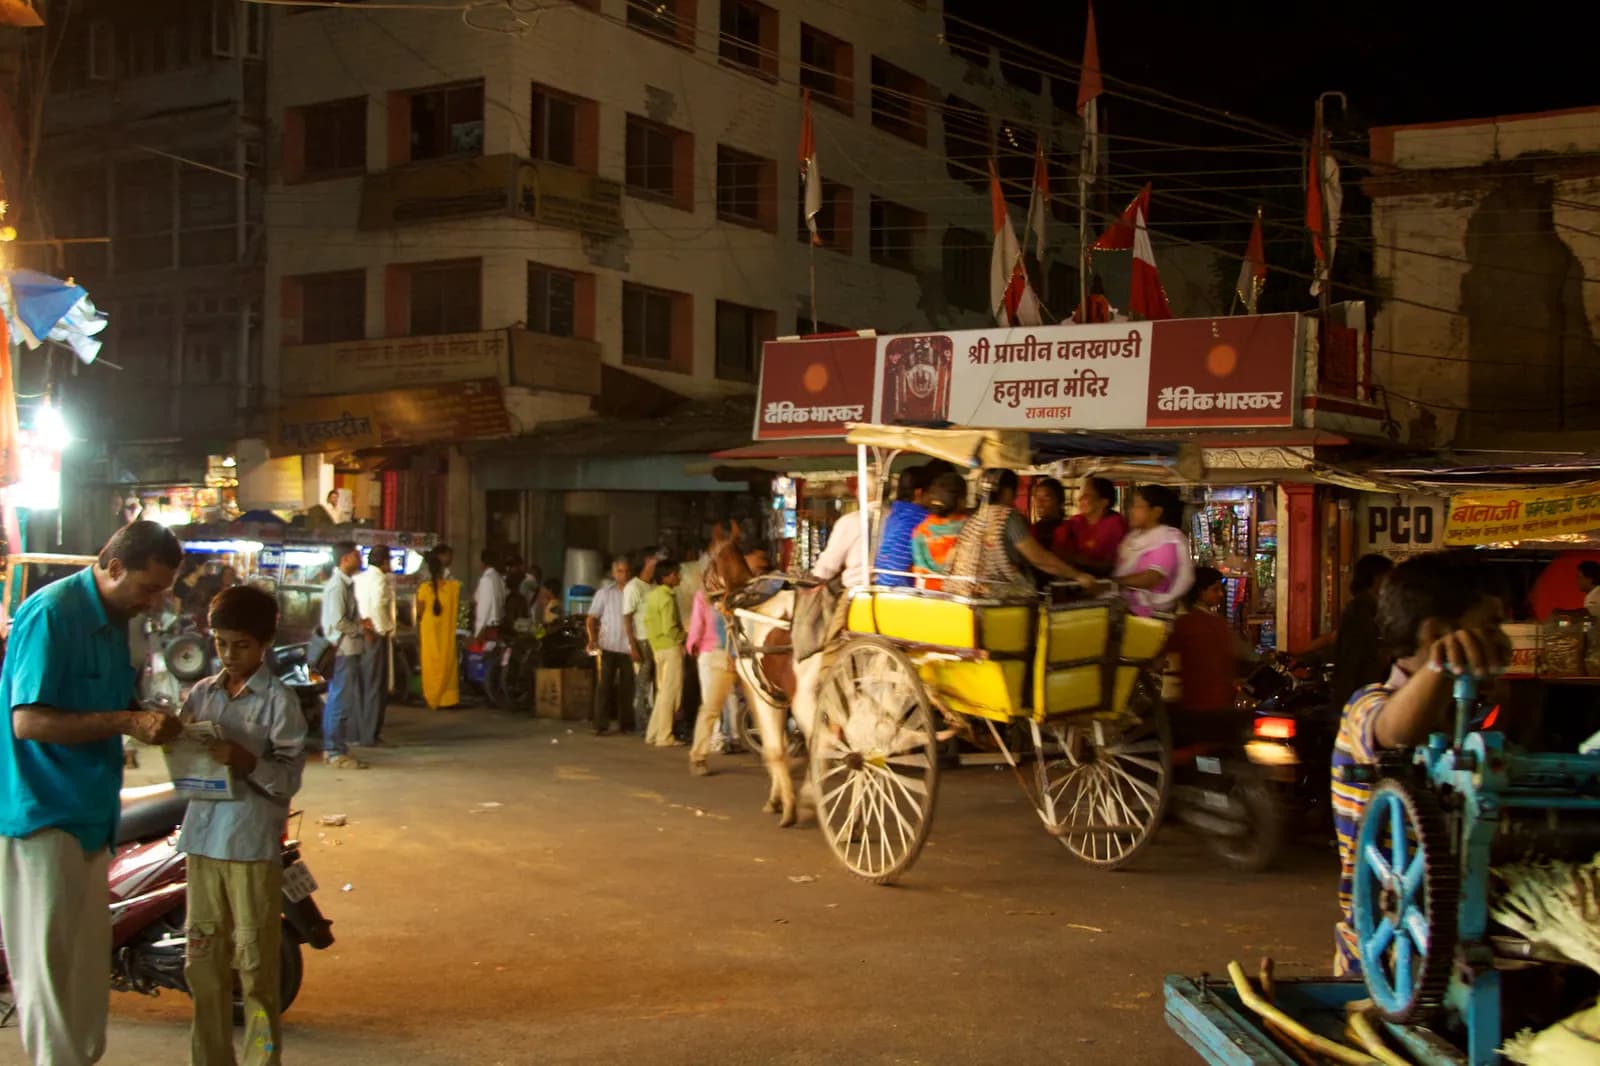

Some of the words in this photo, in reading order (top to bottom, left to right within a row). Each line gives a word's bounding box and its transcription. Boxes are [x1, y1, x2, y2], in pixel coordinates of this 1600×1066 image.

[968, 337, 991, 364] श्री
[993, 334, 1053, 364] प्राचीन
[1057, 330, 1142, 360] वनखण्डी
[993, 378, 1060, 408] हनुमान
[1063, 368, 1110, 398] मंदिर
[1157, 386, 1215, 411] दैनिक
[1215, 392, 1284, 411] भास्कर
[764, 401, 810, 423] दैनिक
[810, 405, 865, 422] भास्कर
[1025, 406, 1072, 420] राजवाड़ा
[1452, 499, 1521, 523] बालाजी
[1368, 506, 1433, 544] PCO
